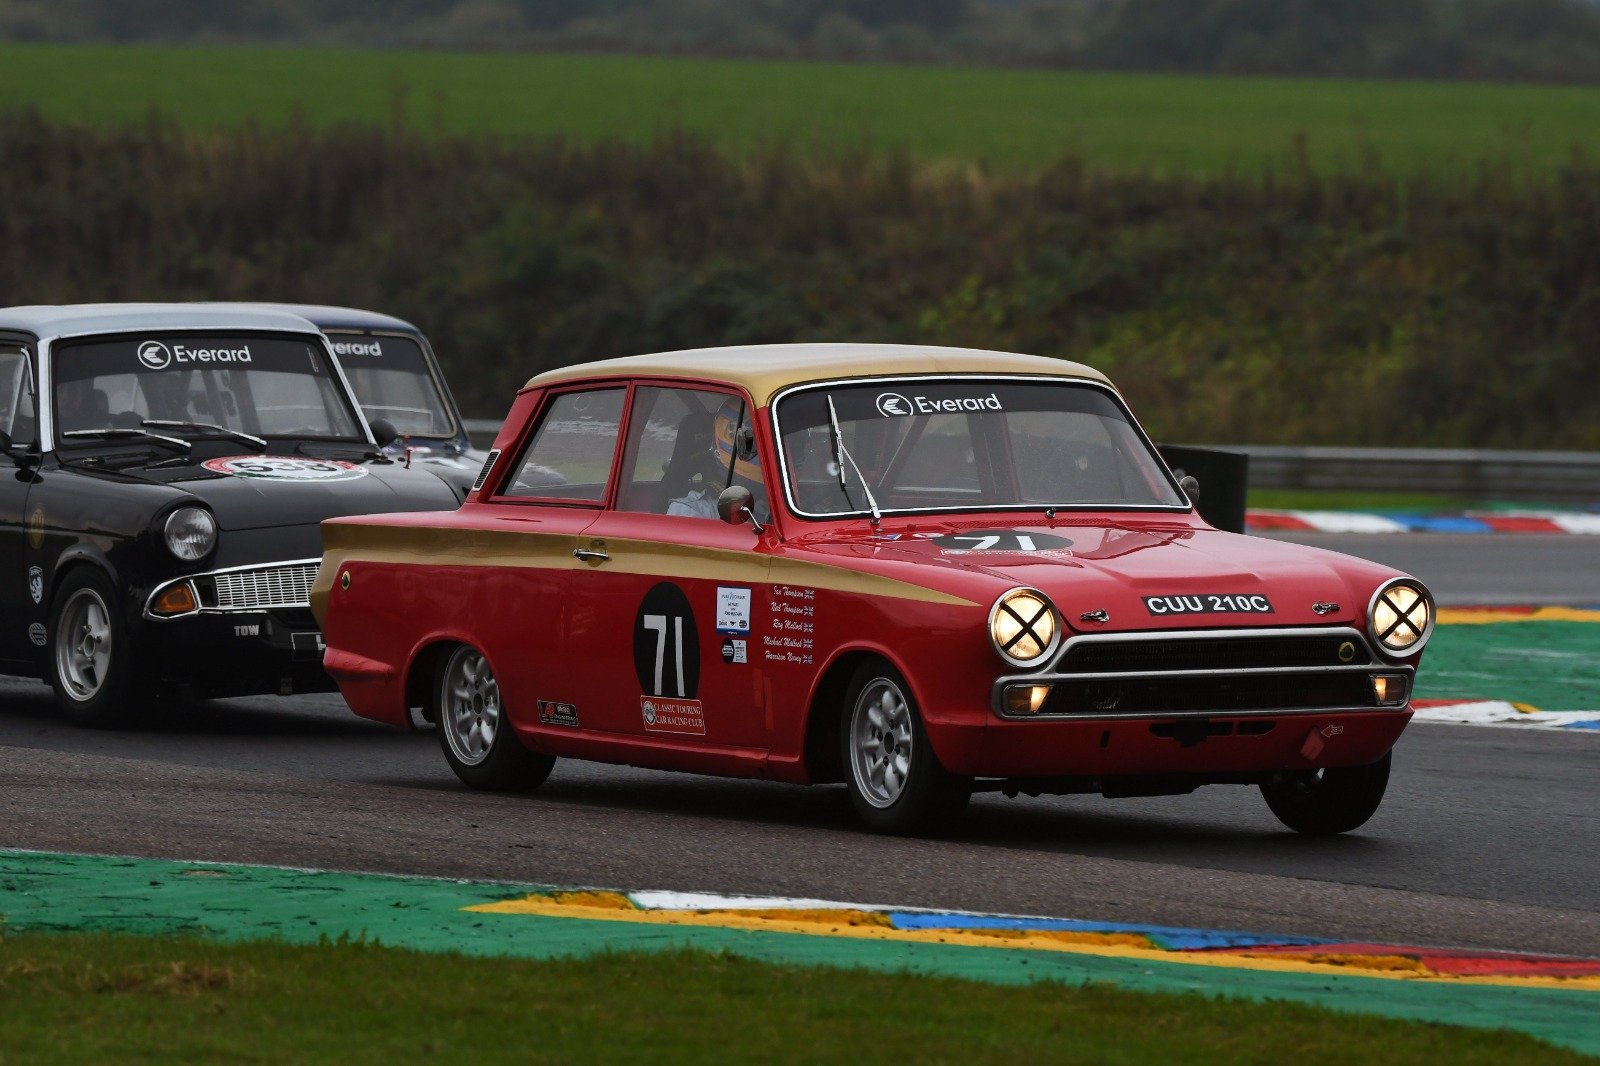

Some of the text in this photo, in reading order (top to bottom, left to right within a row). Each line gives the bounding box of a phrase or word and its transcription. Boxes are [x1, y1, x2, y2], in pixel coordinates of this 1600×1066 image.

[173, 345, 252, 362] Everard
[914, 393, 1003, 413] Everard
[954, 535, 1037, 551] 71
[782, 586, 804, 598] Thompson
[782, 603, 804, 615] Thompson
[1147, 596, 1269, 613] CUU 210C
[233, 625, 259, 636] TOW
[643, 614, 686, 697] 71
[654, 703, 701, 715] CLASSIC TOURING
[656, 715, 703, 728] CAR RACING CLUB
